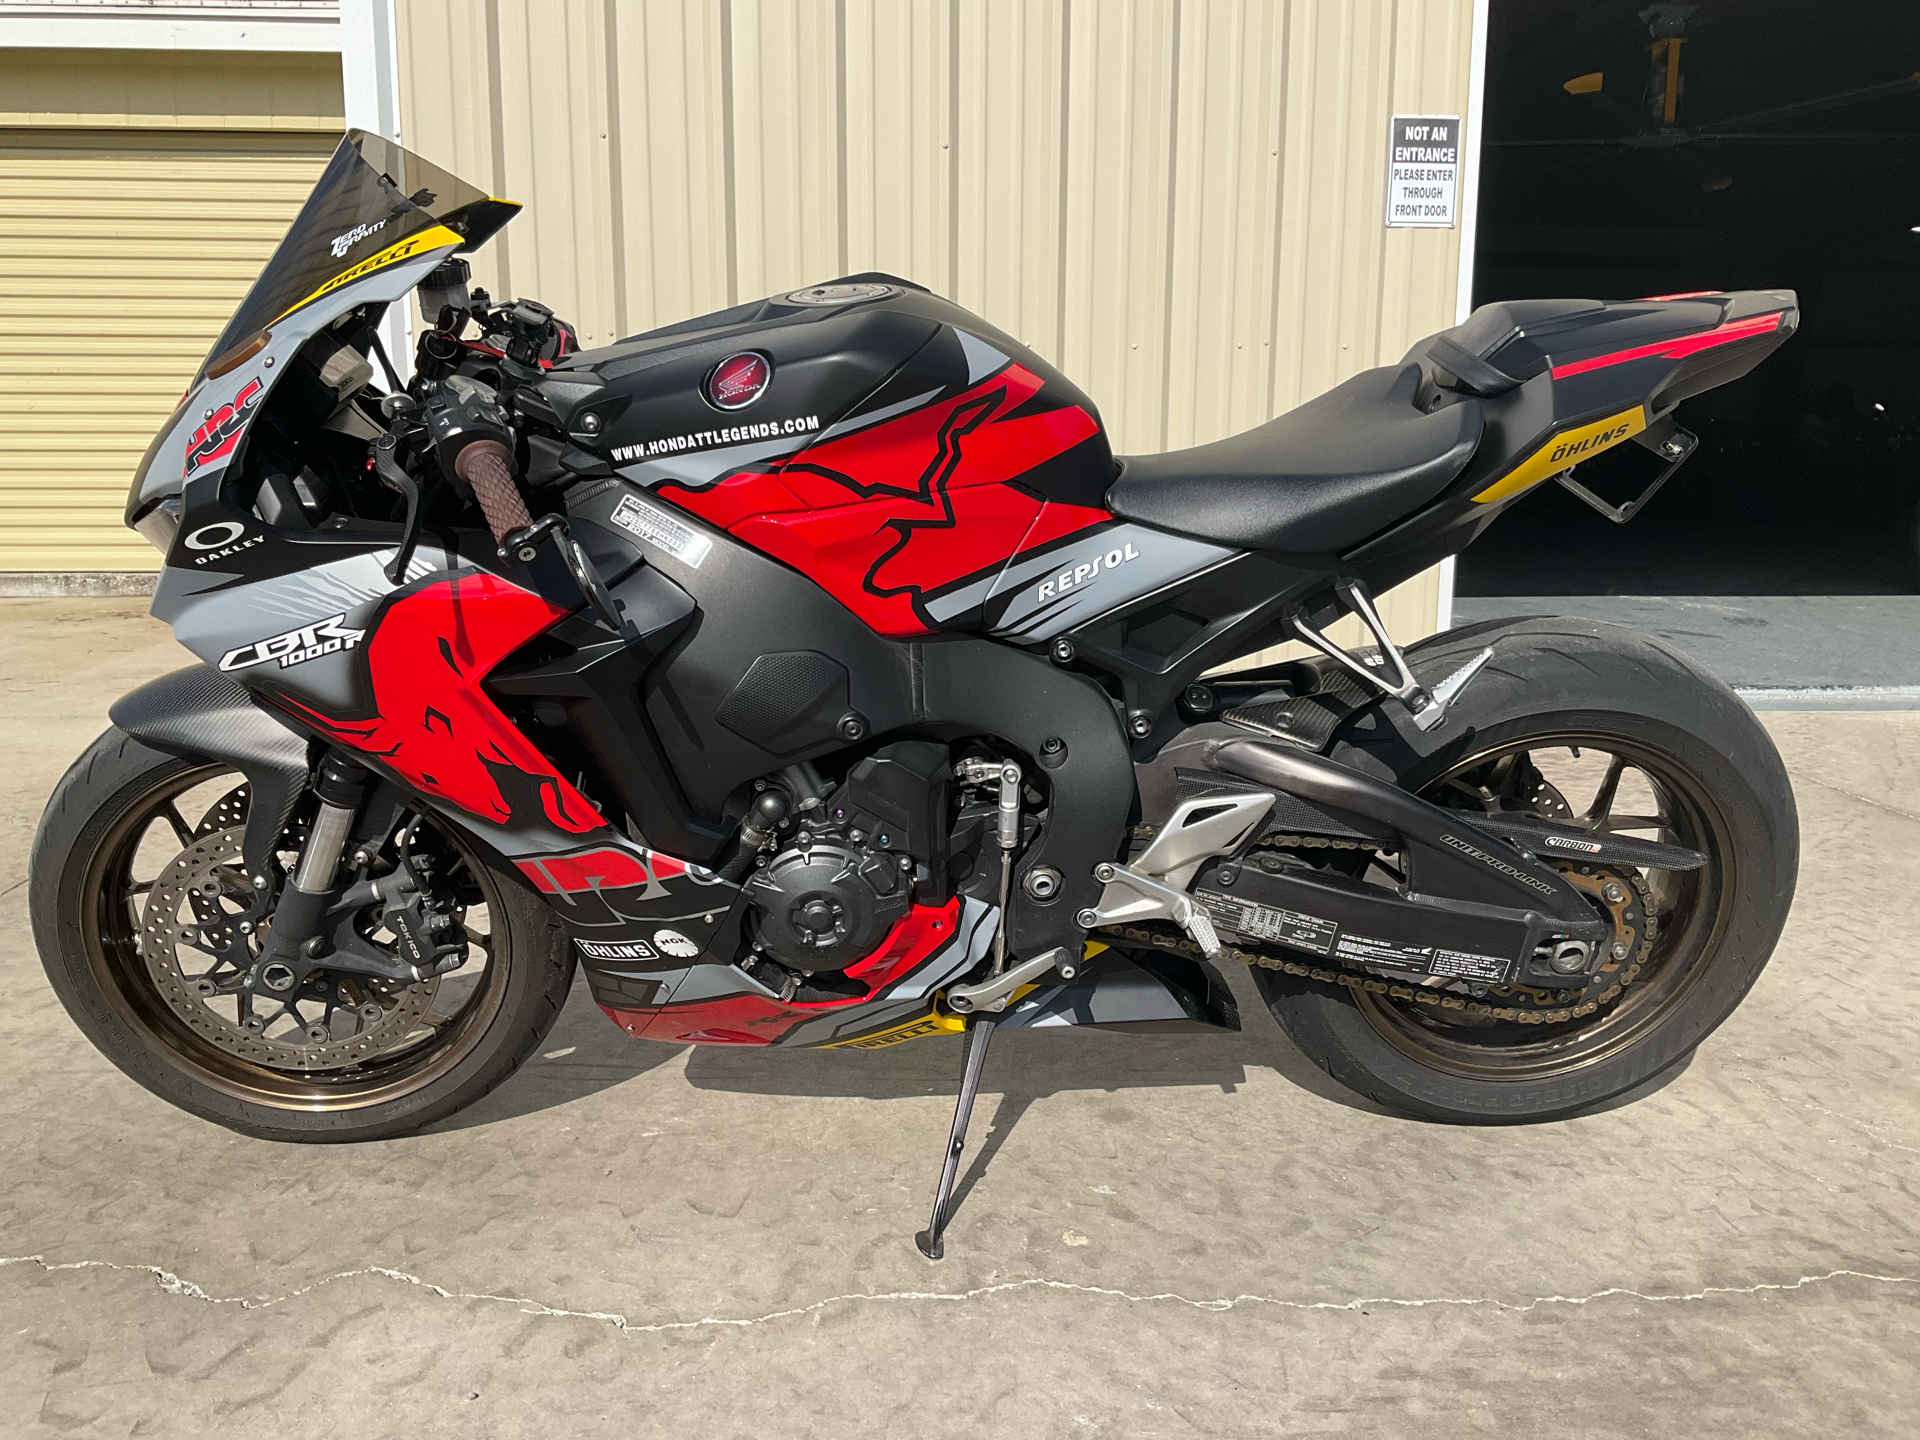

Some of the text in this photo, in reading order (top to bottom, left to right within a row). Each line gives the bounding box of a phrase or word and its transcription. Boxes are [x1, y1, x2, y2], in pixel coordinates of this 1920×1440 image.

[1405, 126, 1448, 141] NOT AN
[1395, 147, 1455, 162] ENTRANCE
[1394, 168, 1454, 182] PLEASE ENTER
[1403, 187, 1443, 199] THROUGH
[1395, 204, 1448, 217] FRONT DOOR
[330, 223, 366, 256] ZERO
[336, 219, 387, 258] GRAVITY
[718, 383, 761, 400] HONDA
[187, 375, 265, 477] HRC
[611, 415, 820, 461] WWW.HONDATTLEGENDS.COM
[1550, 423, 1630, 463] ÖHLINS
[628, 523, 652, 540] 2017
[195, 534, 265, 565] OAKLEY
[1038, 542, 1140, 603] REPSOL
[218, 612, 362, 672] CBR
[1545, 837, 1595, 851] CARBON
[1439, 834, 1558, 895] UNIT PRO-LINK
[397, 915, 420, 959] TOKICO
[580, 938, 687, 958] ÖHLINS NGK
[833, 1020, 941, 1050] PIRELLI
